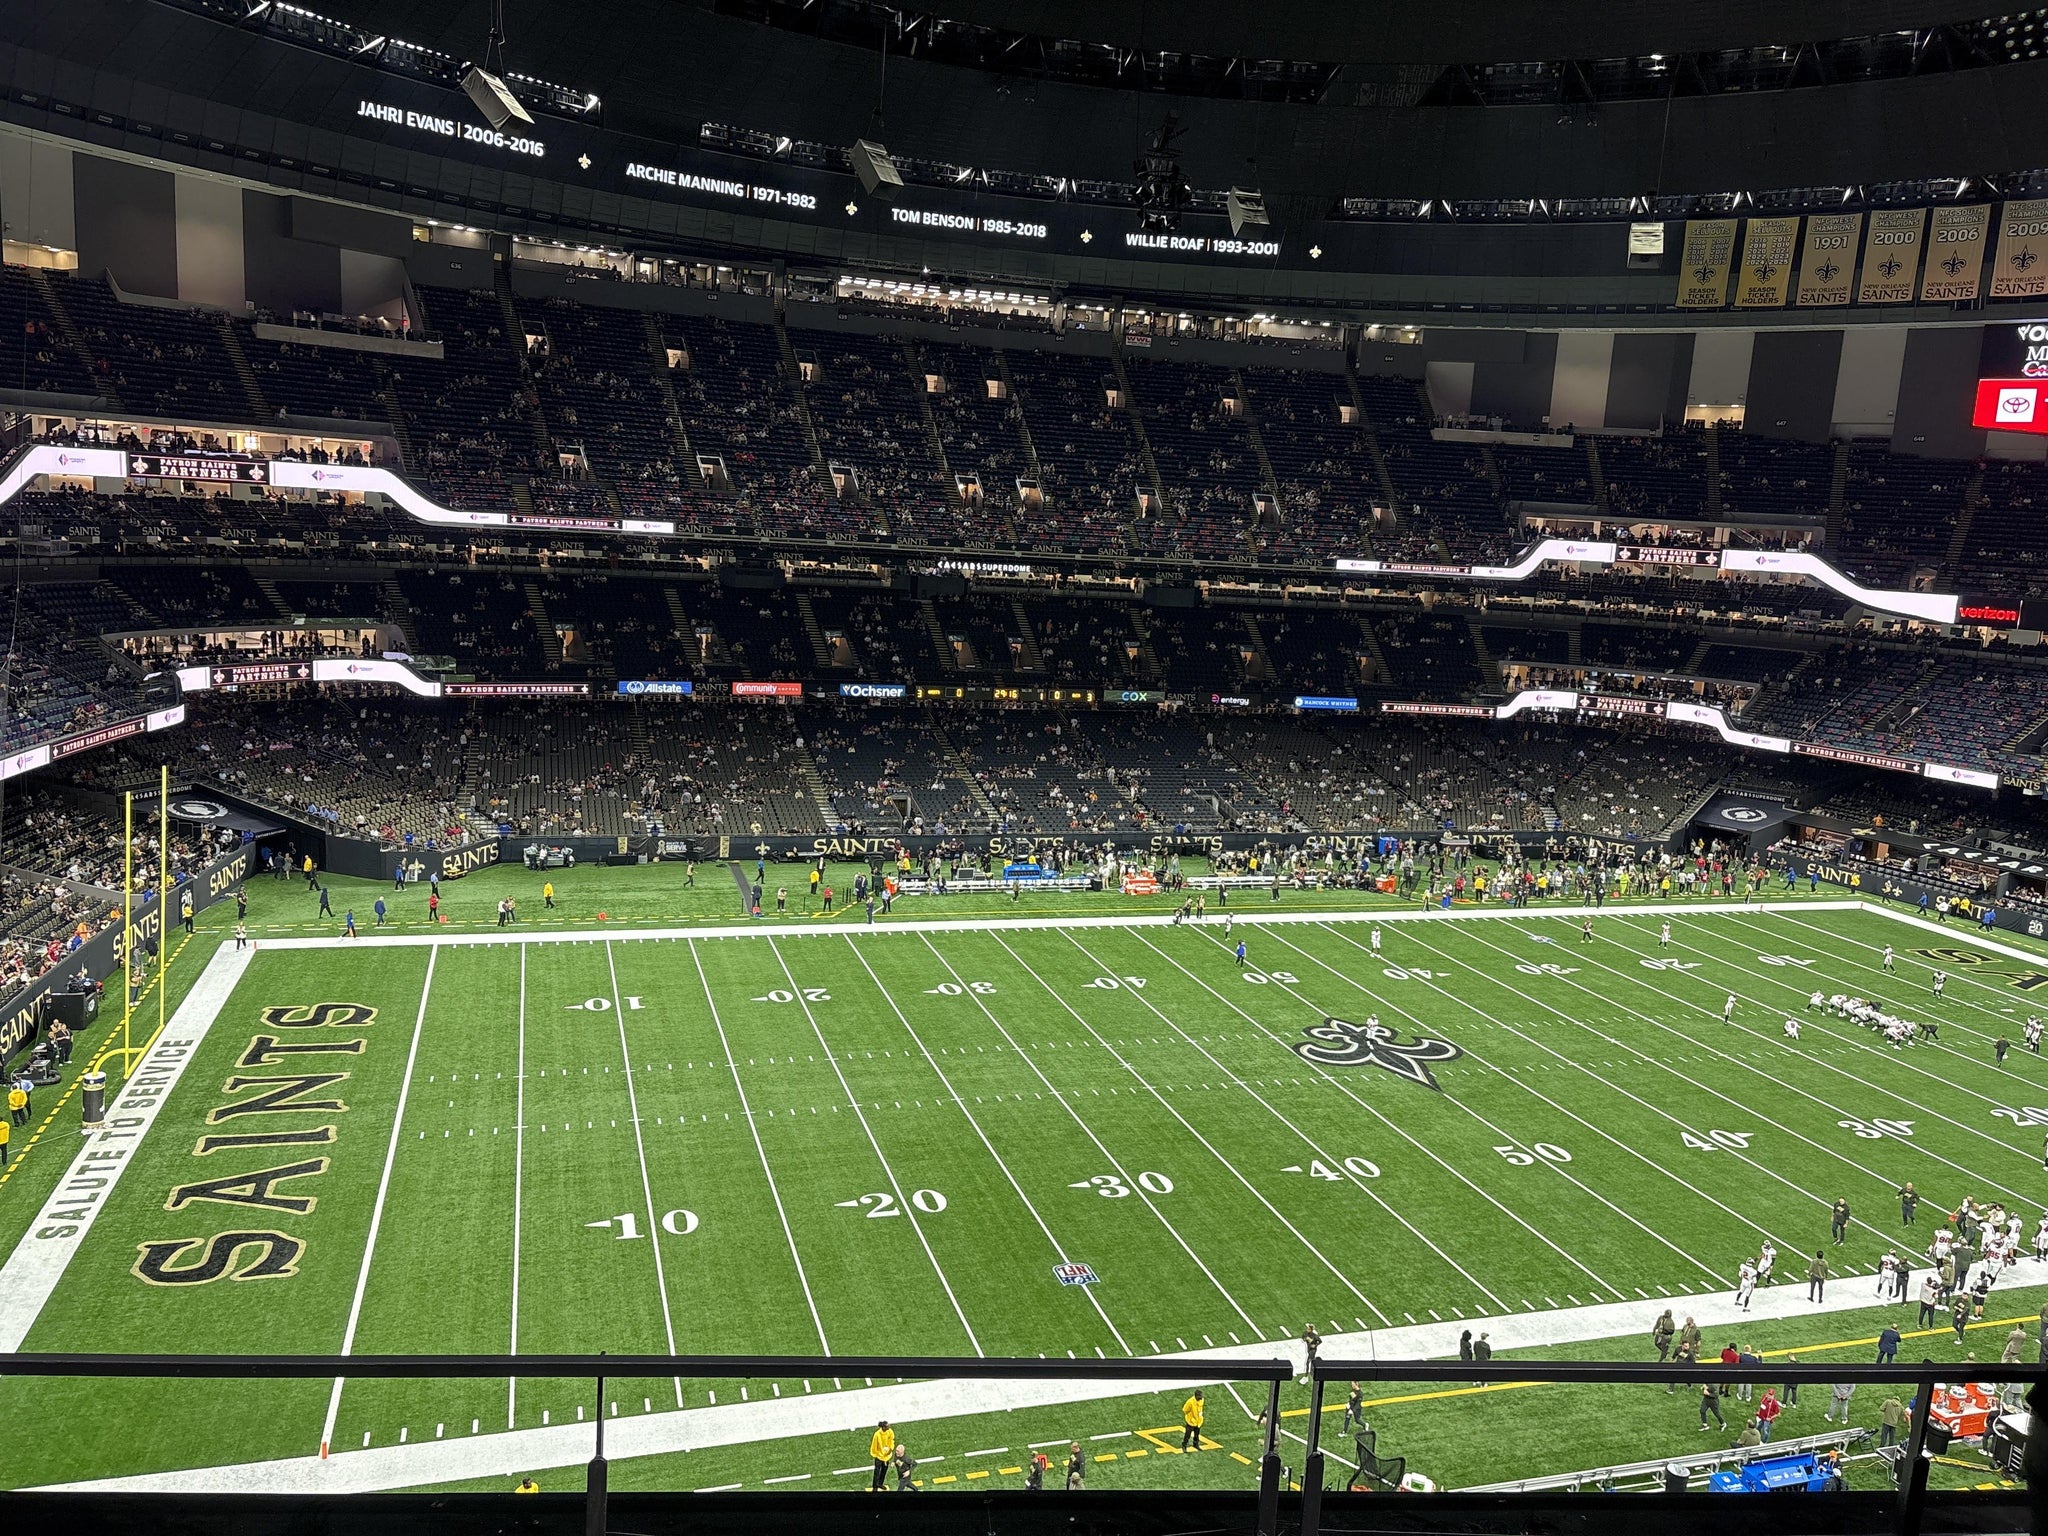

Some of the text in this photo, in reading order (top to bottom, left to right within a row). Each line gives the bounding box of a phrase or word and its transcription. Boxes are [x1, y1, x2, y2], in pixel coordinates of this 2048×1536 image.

[357, 101, 544, 157] JAHRI EVANS 2006-2016
[626, 163, 816, 209] ARCHIE MANNING 1971-1982
[2027, 202, 2048, 210] SOU
[1878, 211, 1918, 220] NFC WEST
[2008, 209, 2048, 218] CHAMPION
[892, 208, 1046, 238] TOM BENSON 1985-2018
[1832, 216, 1855, 224] WEST
[1874, 219, 1920, 227] CHAMPIONS
[1938, 215, 1984, 224] CHAMPIONS
[1811, 224, 1856, 232] CHAMPIONS
[2007, 222, 2048, 237] 2009
[1873, 231, 1915, 245] 2000
[1936, 228, 1979, 242] 2006
[1126, 234, 1278, 255] WILLIE ROAF 1993-2001
[1814, 236, 1849, 250] 1991
[1926, 287, 1974, 298] SAINTS
[1995, 282, 2044, 294] SAINTS
[1800, 293, 1846, 303] SAINTS
[1862, 289, 1909, 300] SAINTS
[160, 459, 237, 470] PATRON SAINTS
[160, 466, 238, 478] PARTNERS
[69, 526, 100, 536] SAINTS
[142, 526, 177, 536] SAINTS
[220, 528, 257, 539] SAINTS
[679, 525, 713, 534] SAINTS
[754, 530, 788, 538] SAINTS
[302, 531, 339, 541] SAINTS
[388, 534, 424, 543] SAINTS
[826, 533, 859, 542] SAINTS
[896, 536, 928, 546] SAINTS
[469, 537, 504, 547] SAINTS
[550, 541, 584, 550] SAINTS
[964, 541, 995, 550] SAINTS
[626, 544, 659, 553] SAINTS
[702, 549, 734, 558] SAINTS
[1032, 545, 1063, 553] SAINTS
[1098, 548, 1128, 556] SAINTS
[773, 551, 804, 560] SAINTS
[1164, 552, 1194, 560] SAINTS
[1228, 554, 1258, 563] SAINTS
[938, 561, 1031, 572] CAESARS SUPERDOME
[1293, 559, 1323, 567] SAINTS
[1156, 572, 1183, 580] SAINTS
[1470, 587, 1497, 595] SAINTS
[1537, 591, 1566, 599] SAINTS
[1603, 595, 1633, 604] SAINTS
[1674, 601, 1704, 610] SAINTS
[1742, 606, 1773, 615] SAINTS
[1959, 606, 2017, 621] verizon
[695, 683, 728, 691] SAINTS
[736, 683, 777, 694] Community
[851, 685, 904, 697] Ochsner
[1122, 692, 1148, 702] COX
[1168, 693, 1196, 701] SAINTS
[1220, 697, 1249, 706] entergy
[2003, 776, 2041, 791] SAINTS
[131, 785, 192, 801] AESARS SPERDOME
[814, 838, 896, 855] SAINTS
[443, 843, 499, 871] SAINTS
[1922, 843, 2048, 877] CAESAR
[210, 854, 247, 896] SAINTS
[1806, 863, 1860, 887] SAINTS
[2028, 920, 2044, 933] 20
[113, 908, 159, 962] SAINTS
[1091, 974, 1149, 990] 40
[1242, 972, 1300, 984] 50
[938, 980, 997, 996] 30
[767, 987, 832, 1003] 20
[585, 996, 645, 1011] 10
[0, 987, 51, 1055] SAINT
[1990, 1106, 2048, 1126] 20
[1837, 1118, 1913, 1139] 30
[35, 1038, 195, 1240] SALUTE TO SERVICE
[130, 1002, 378, 1287] SAINTS
[1680, 1130, 1749, 1151] 40
[1493, 1142, 1573, 1167] 50
[1305, 1156, 1381, 1181] 40
[1090, 1170, 1174, 1199] 30
[859, 1188, 948, 1218] 20
[612, 1209, 699, 1240] 10
[1058, 1265, 1088, 1276] NFL
